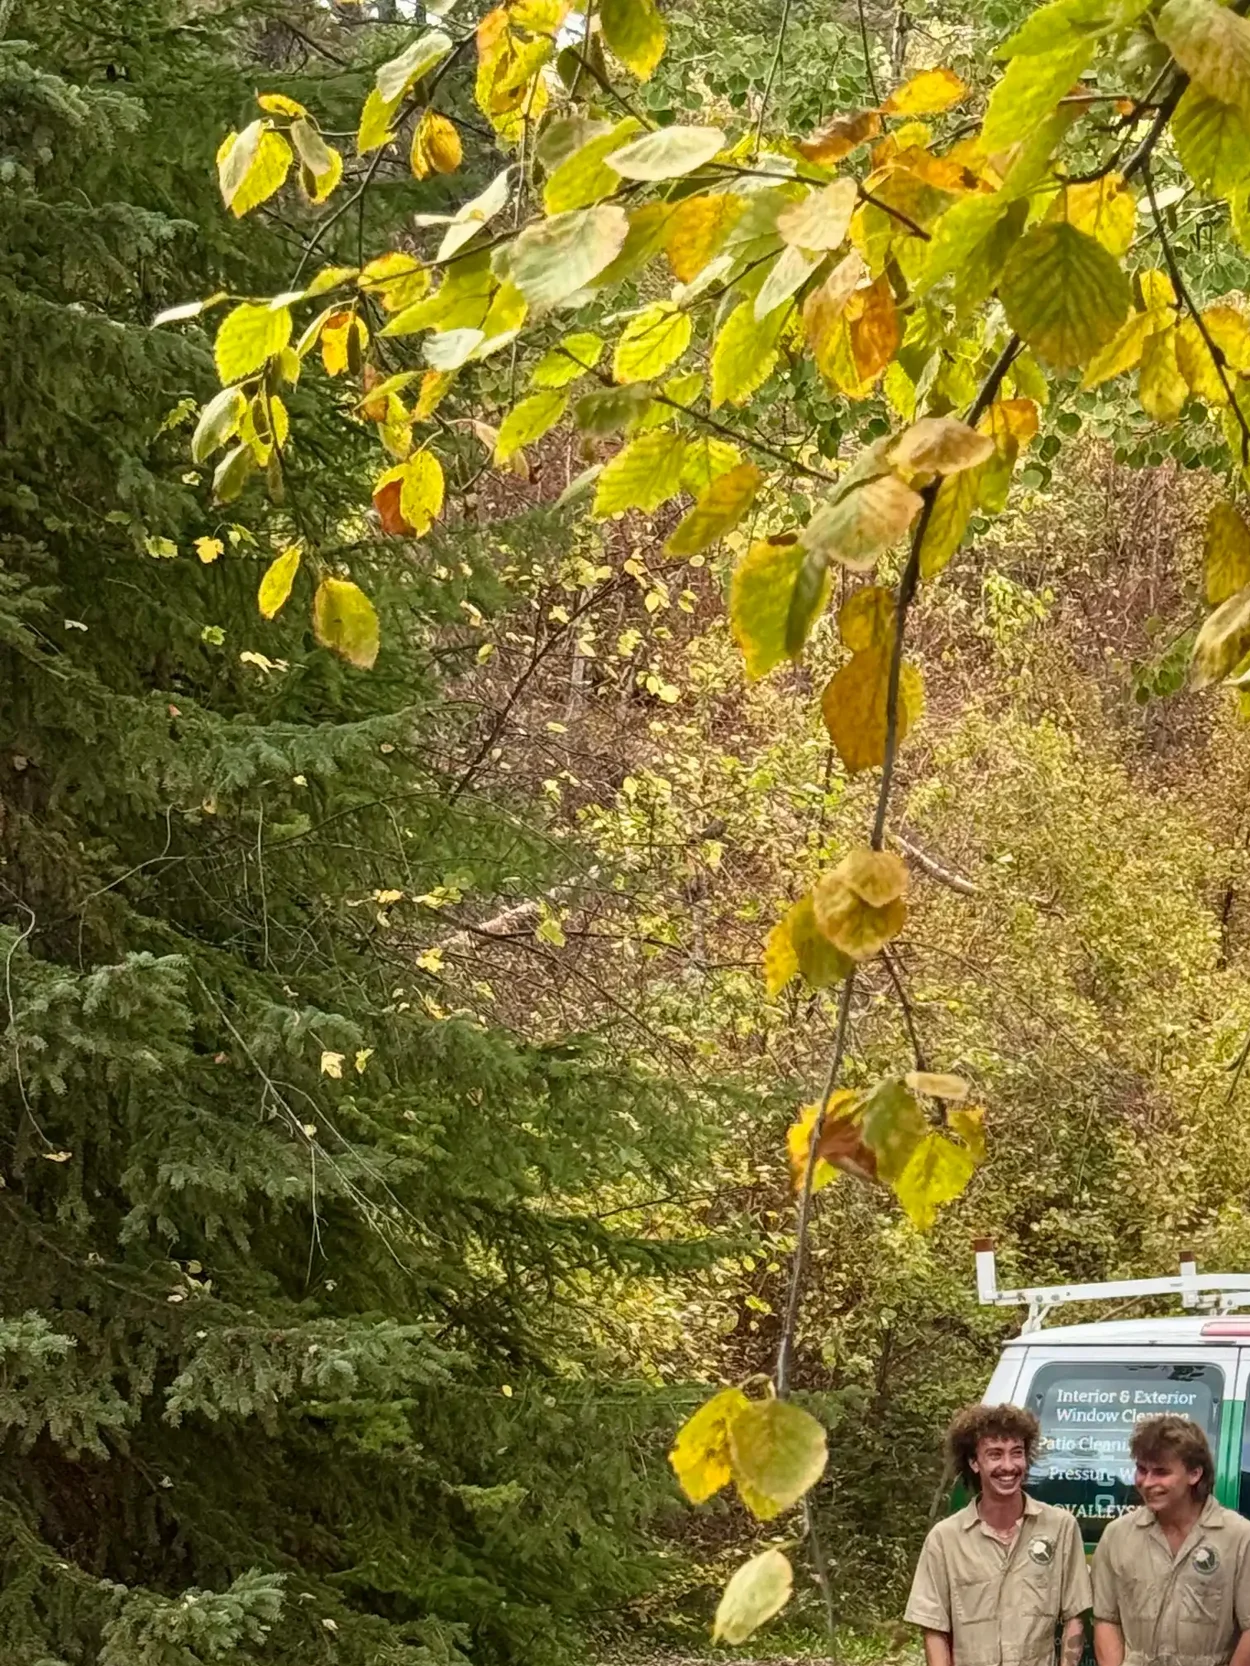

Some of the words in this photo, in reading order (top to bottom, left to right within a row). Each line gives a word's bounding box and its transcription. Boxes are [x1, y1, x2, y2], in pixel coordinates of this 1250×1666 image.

[1056, 1389, 1117, 1404] Interior
[1119, 1390, 1130, 1404] &
[1133, 1390, 1197, 1405] Exterior
[1056, 1408, 1120, 1423] Window
